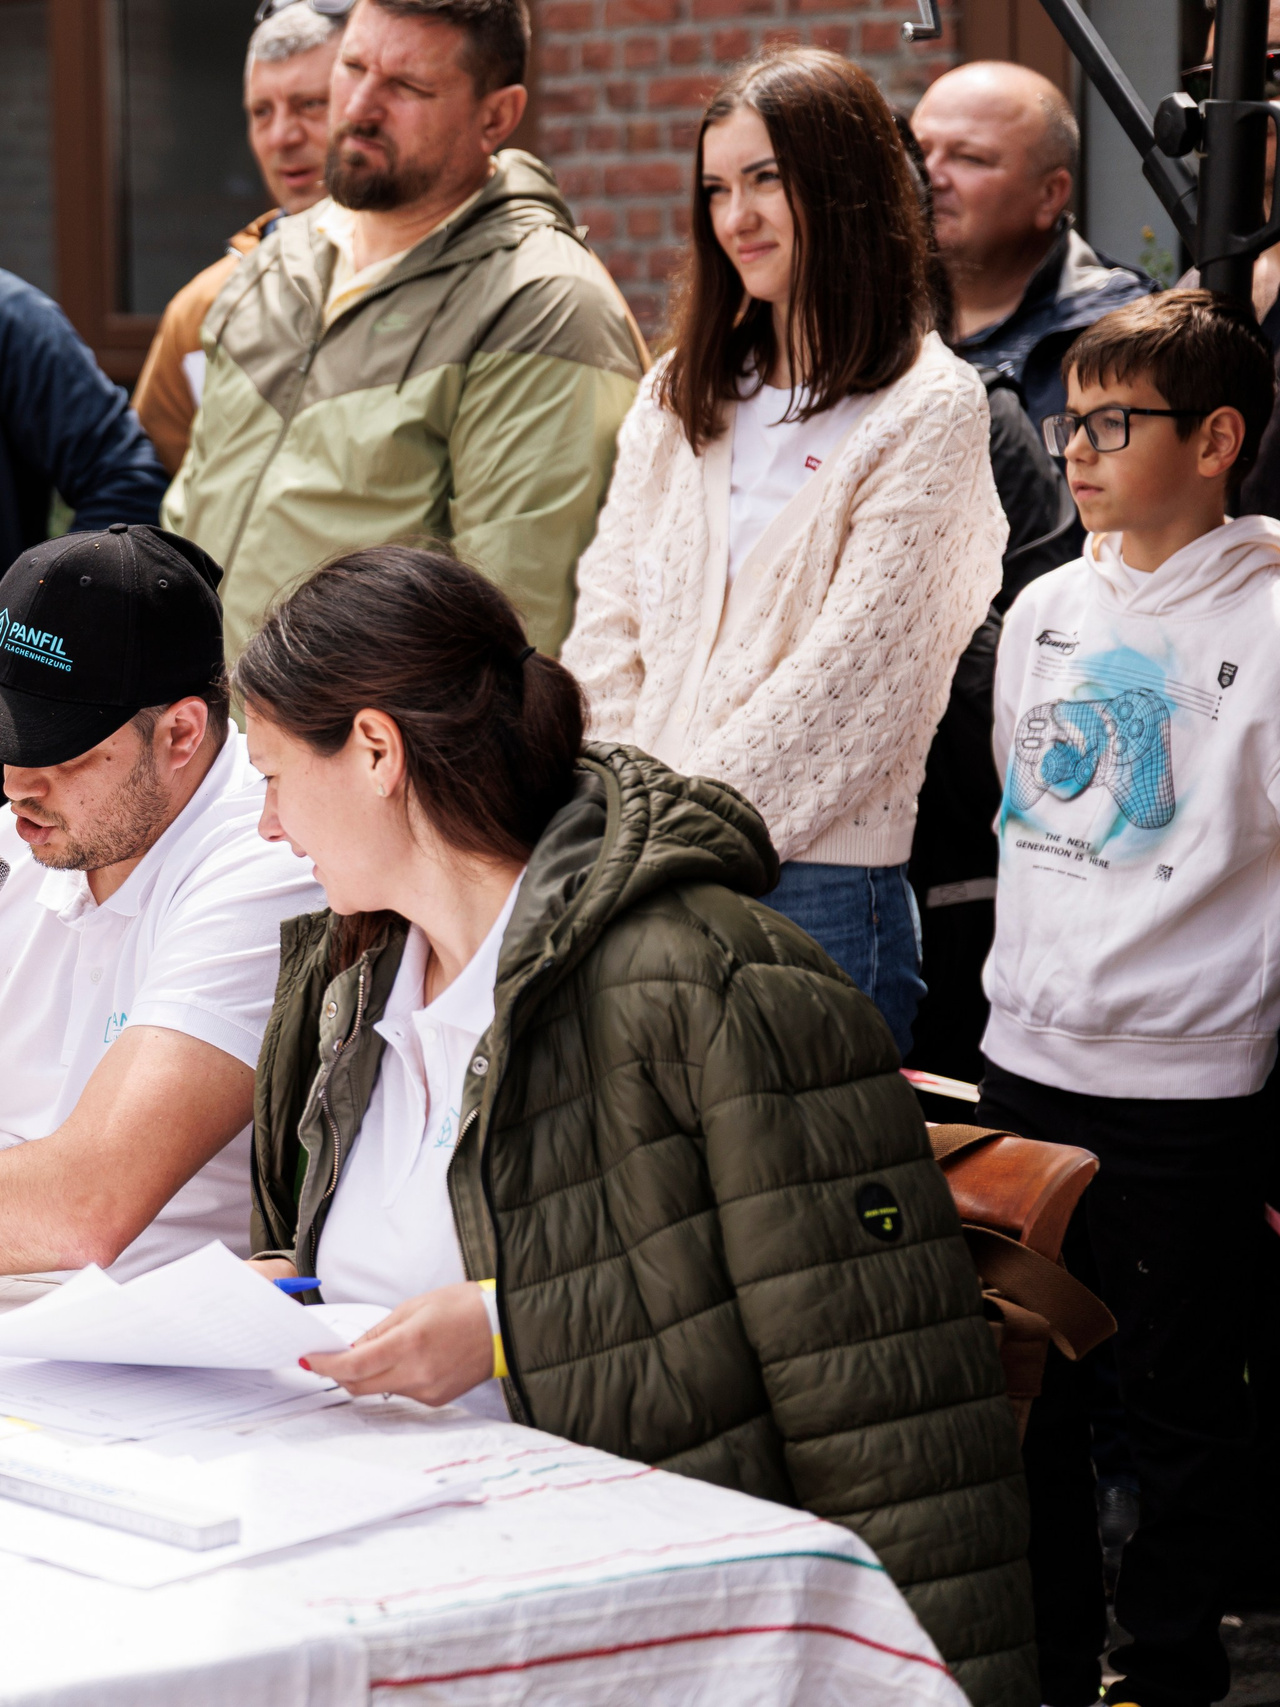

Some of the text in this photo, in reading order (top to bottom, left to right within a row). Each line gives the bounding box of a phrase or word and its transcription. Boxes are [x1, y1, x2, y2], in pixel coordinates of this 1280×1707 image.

[9, 621, 67, 656] PANFIL
[1015, 839, 1111, 870] GENERATION IS HERE
[1045, 832, 1092, 851] THE NEXT
